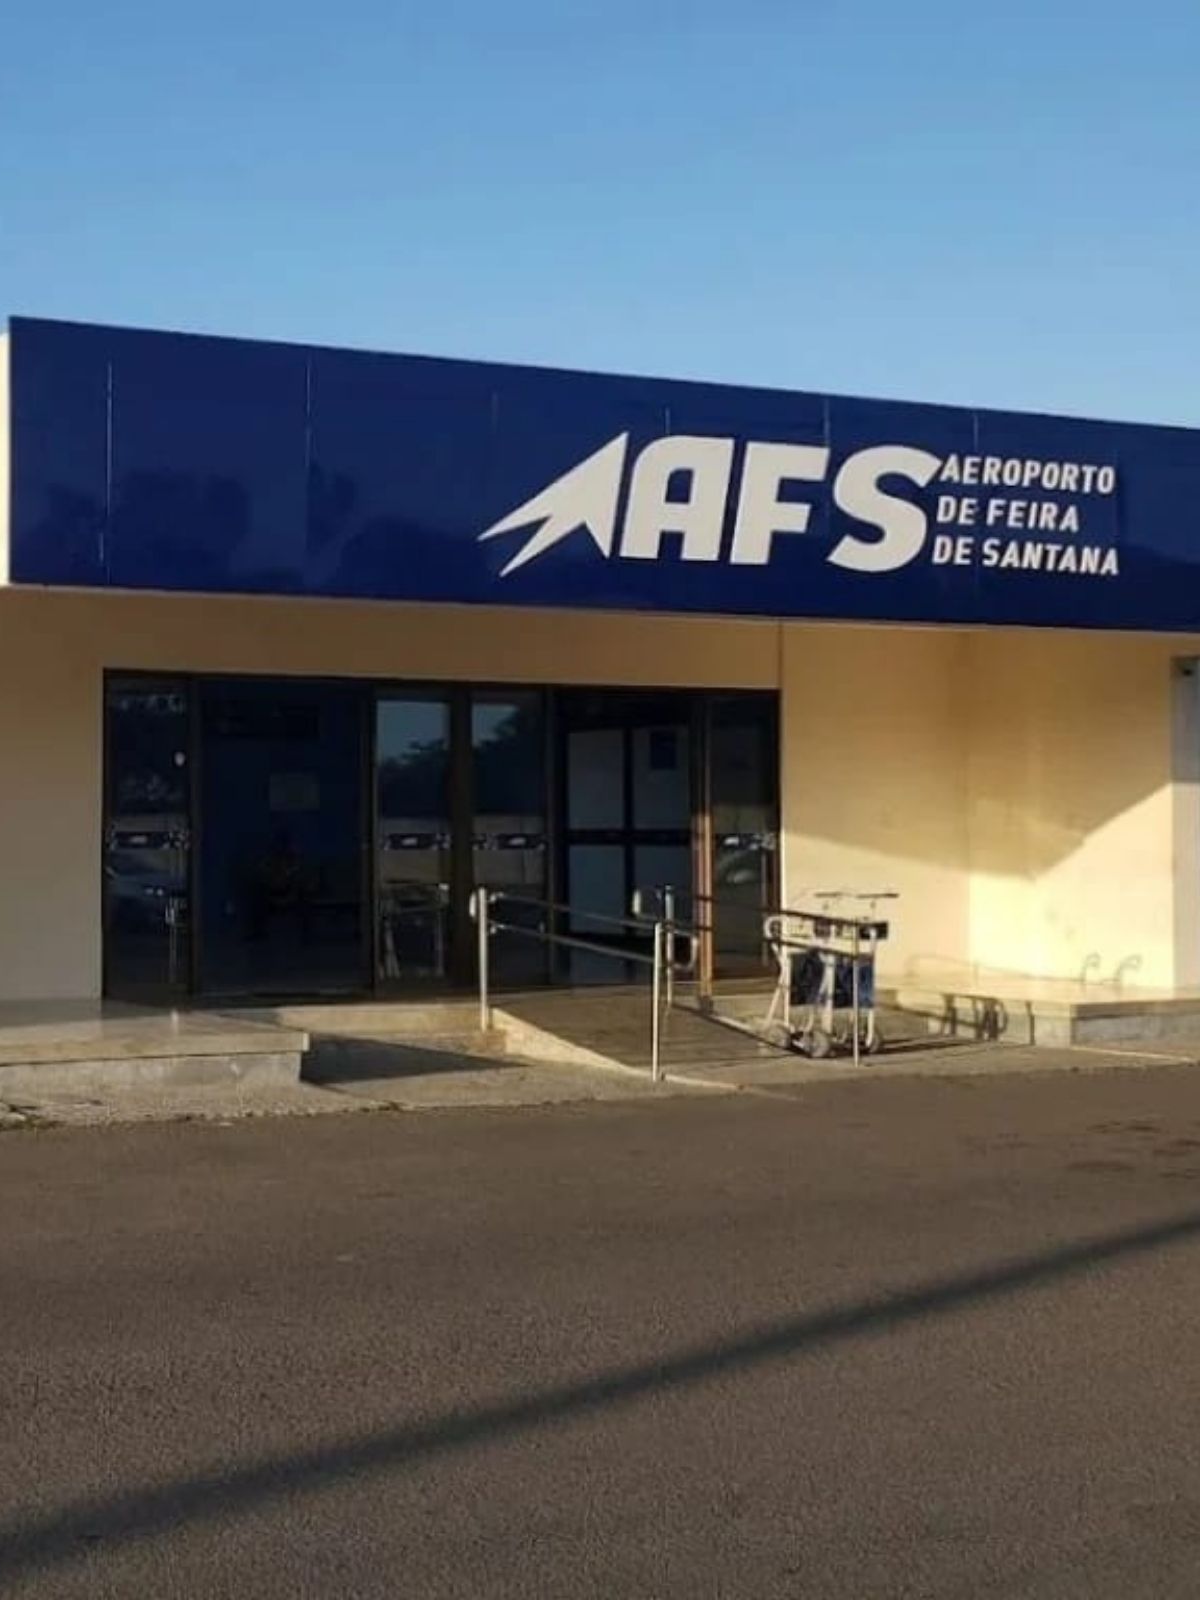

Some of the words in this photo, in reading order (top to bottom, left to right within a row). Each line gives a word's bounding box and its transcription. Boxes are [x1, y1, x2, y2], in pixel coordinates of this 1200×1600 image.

[939, 453, 1116, 495] AEROPORTO
[619, 434, 943, 573] AFS
[936, 495, 978, 525] DE
[986, 498, 1080, 533] FEIRA
[931, 535, 975, 565] DE
[981, 537, 1119, 576] SANTANA
